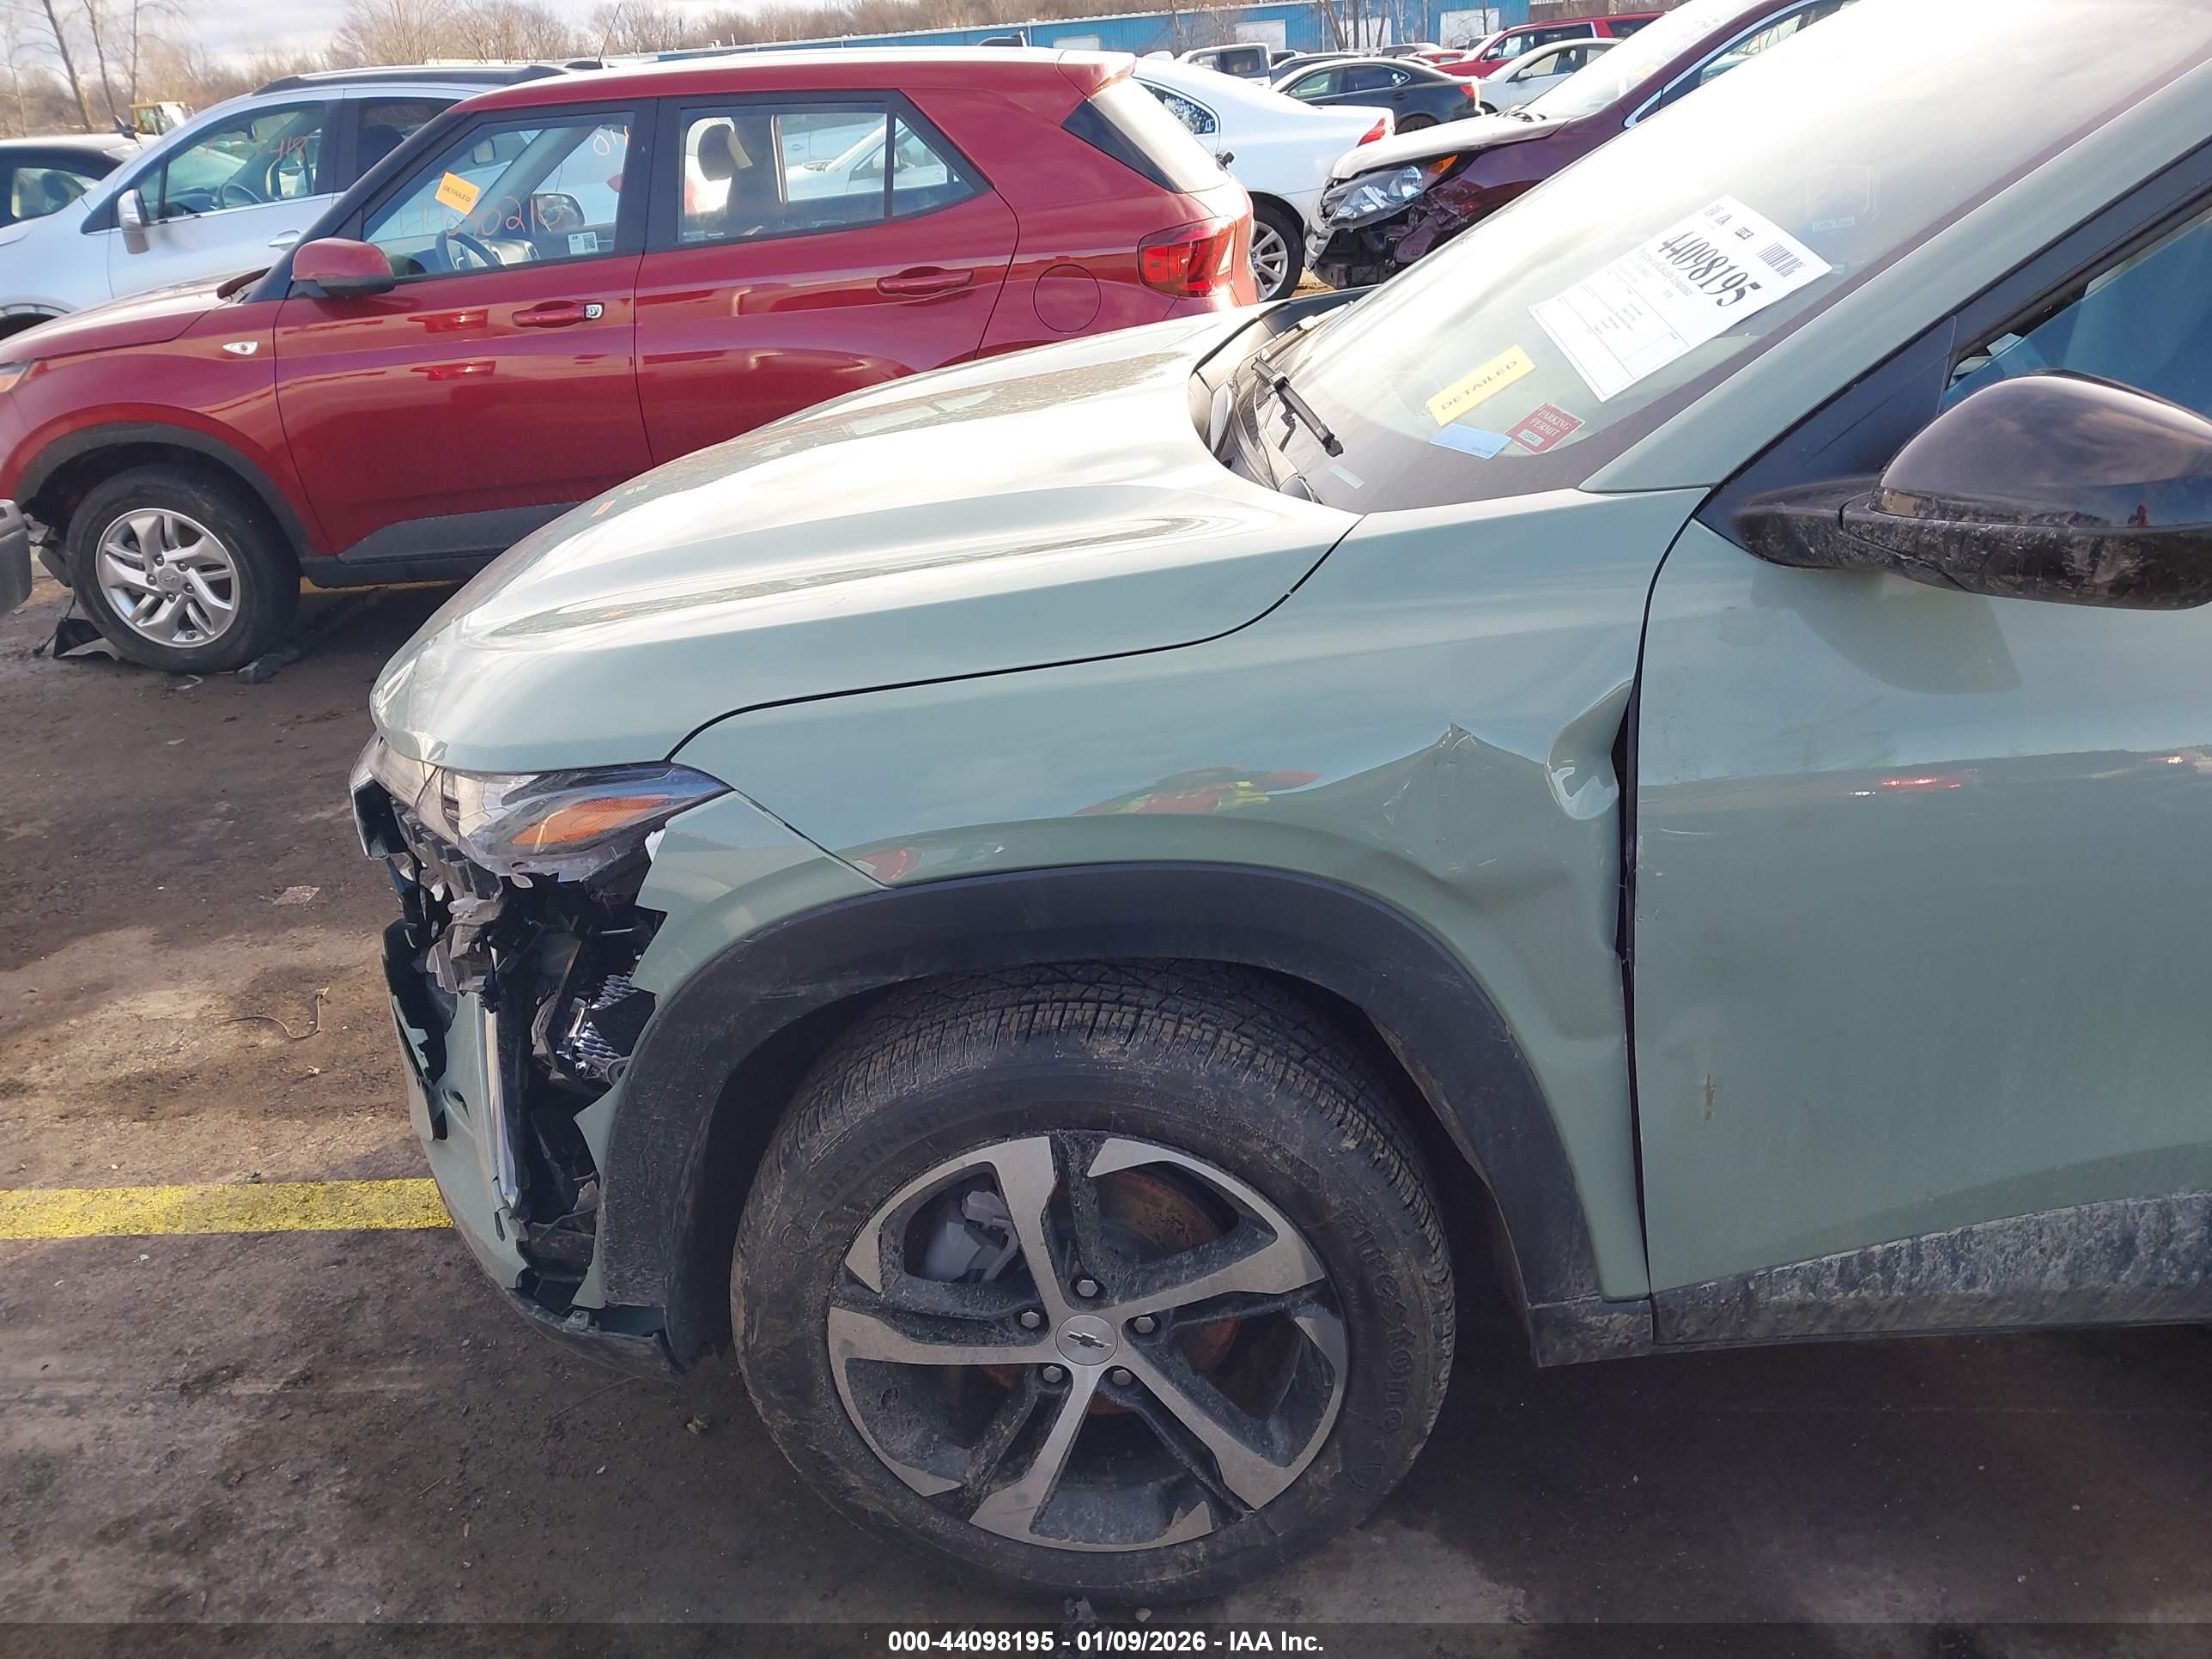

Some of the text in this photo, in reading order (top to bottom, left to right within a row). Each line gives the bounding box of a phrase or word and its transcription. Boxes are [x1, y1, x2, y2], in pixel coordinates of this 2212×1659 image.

[442, 185, 471, 204] DETAILED
[1656, 230, 1762, 307] 44098195
[1440, 360, 1518, 410] DETAILED
[1528, 417, 1561, 437] PERMIT
[1537, 410, 1573, 430] PARKING
